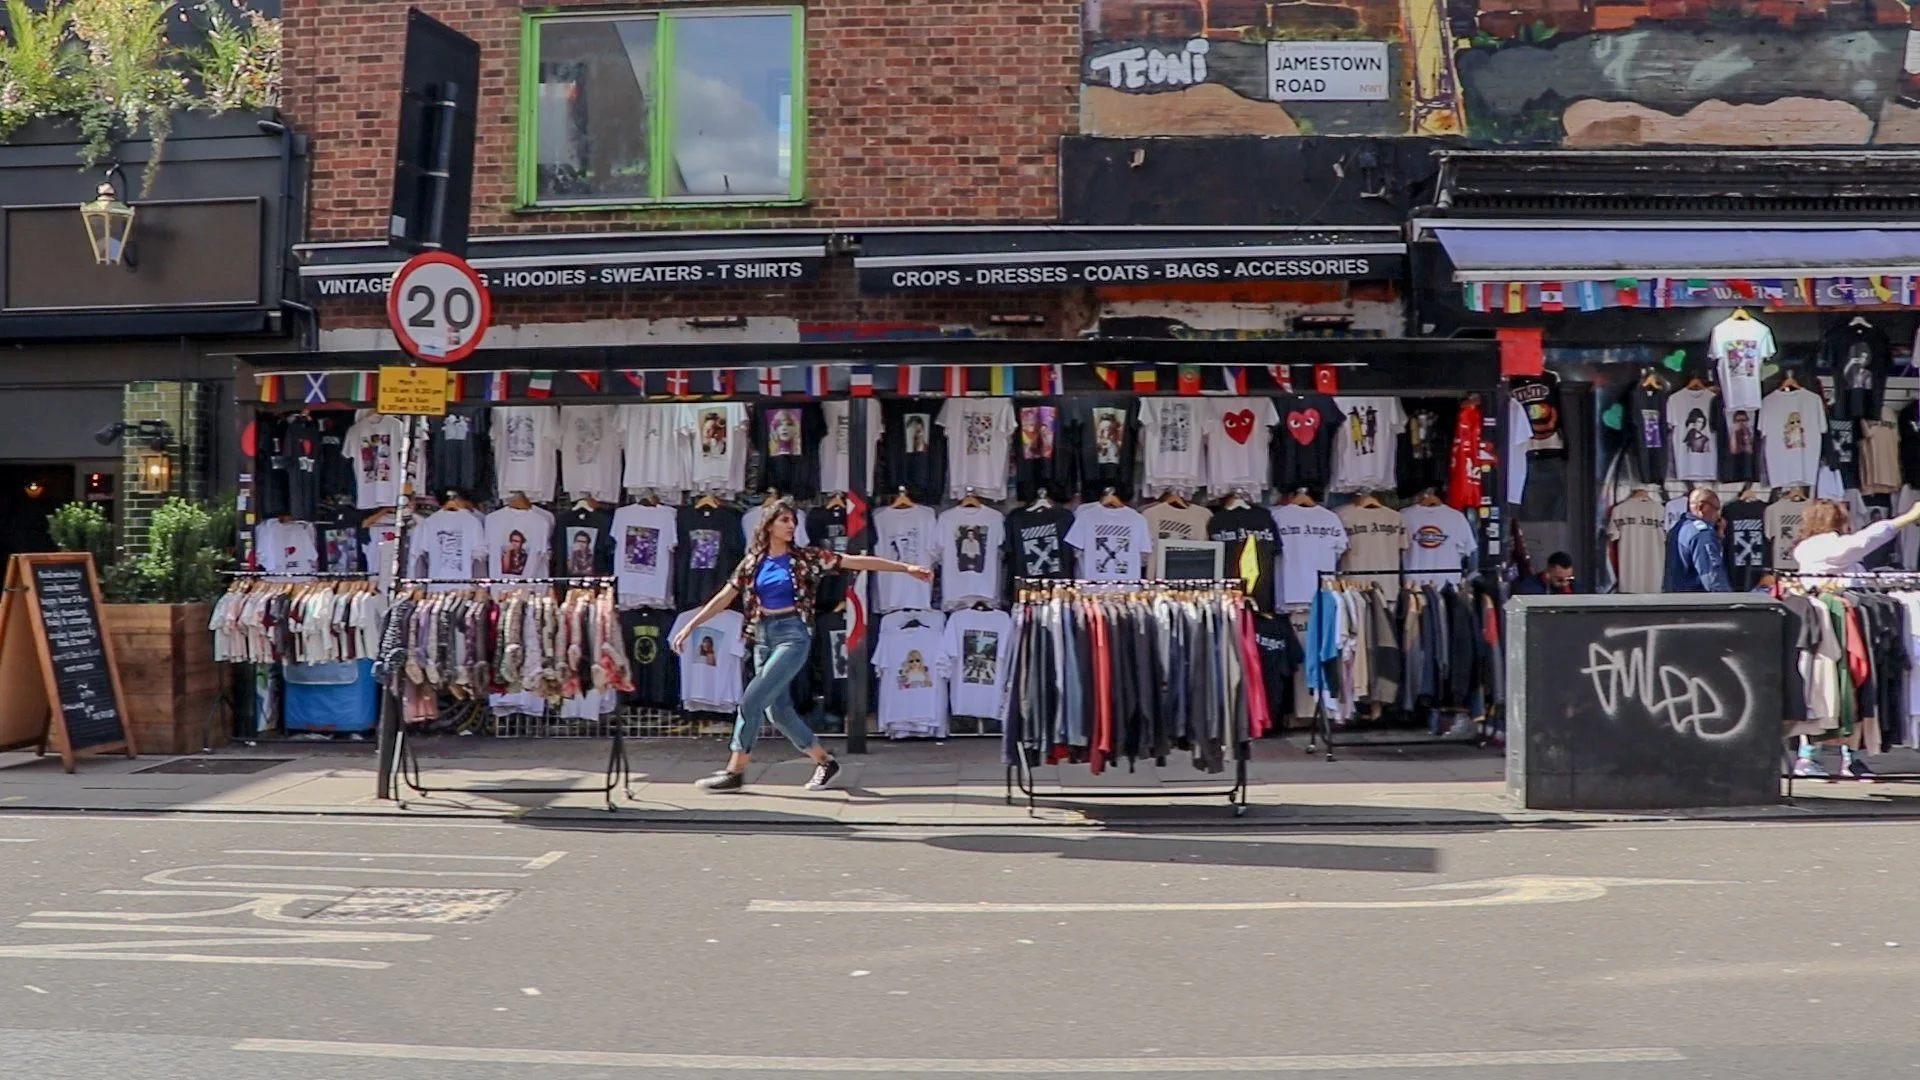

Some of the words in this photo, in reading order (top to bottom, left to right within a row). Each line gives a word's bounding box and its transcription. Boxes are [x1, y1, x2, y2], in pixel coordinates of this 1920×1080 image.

[1275, 56, 1382, 72] JAMESTOWN
[1275, 79, 1326, 93] ROAD
[503, 269, 586, 287] HOODIES
[600, 265, 702, 283] SWEATERS
[717, 264, 730, 279] T
[734, 262, 803, 278] SHIRTS
[892, 270, 961, 287] CROPS
[976, 266, 1068, 284] DRESSES
[1083, 264, 1149, 282] COATS
[1165, 262, 1219, 278] BAGS
[1233, 258, 1370, 277] ACCESSORIES
[406, 284, 475, 330] 20
